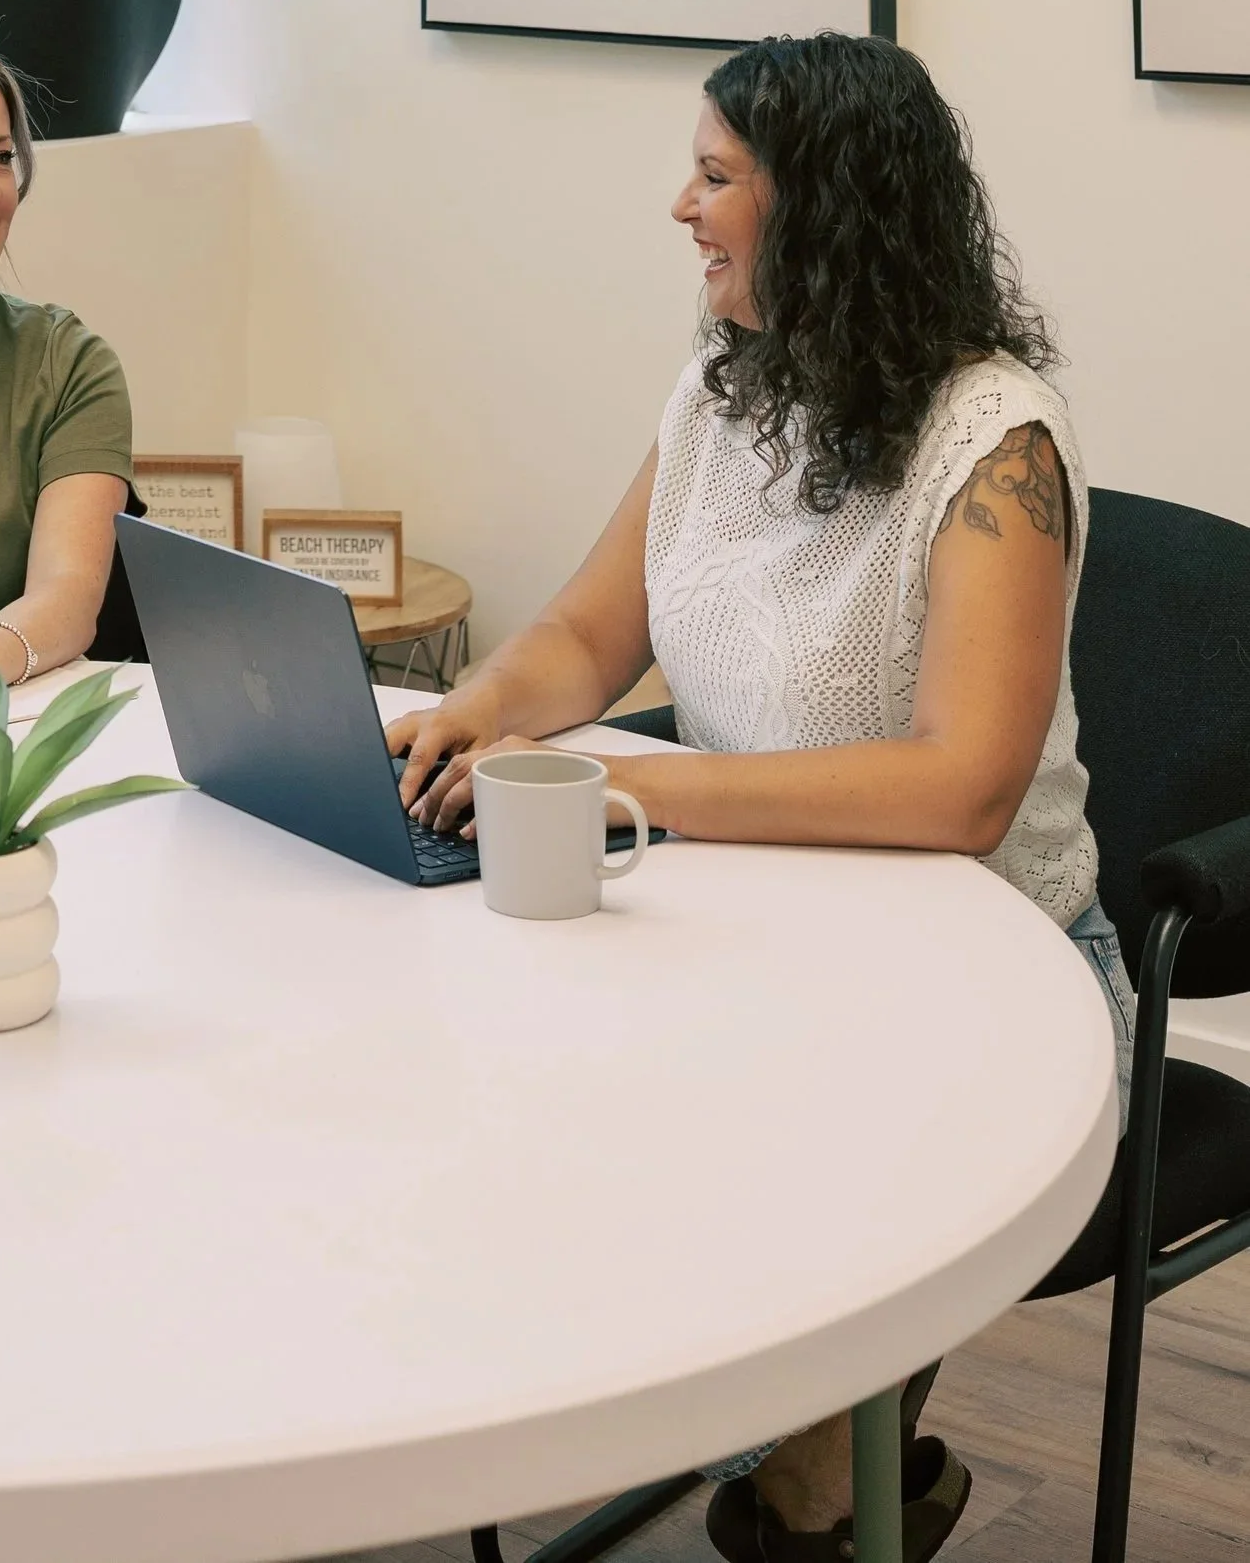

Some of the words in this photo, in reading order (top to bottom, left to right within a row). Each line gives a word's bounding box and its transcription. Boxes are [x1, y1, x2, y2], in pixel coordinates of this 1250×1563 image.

[149, 485, 175, 498] the
[179, 485, 215, 498] best
[147, 505, 222, 521] herapist
[280, 537, 323, 553] BEACH
[326, 538, 384, 554] THERAPY
[324, 569, 382, 582] INSURANCE
